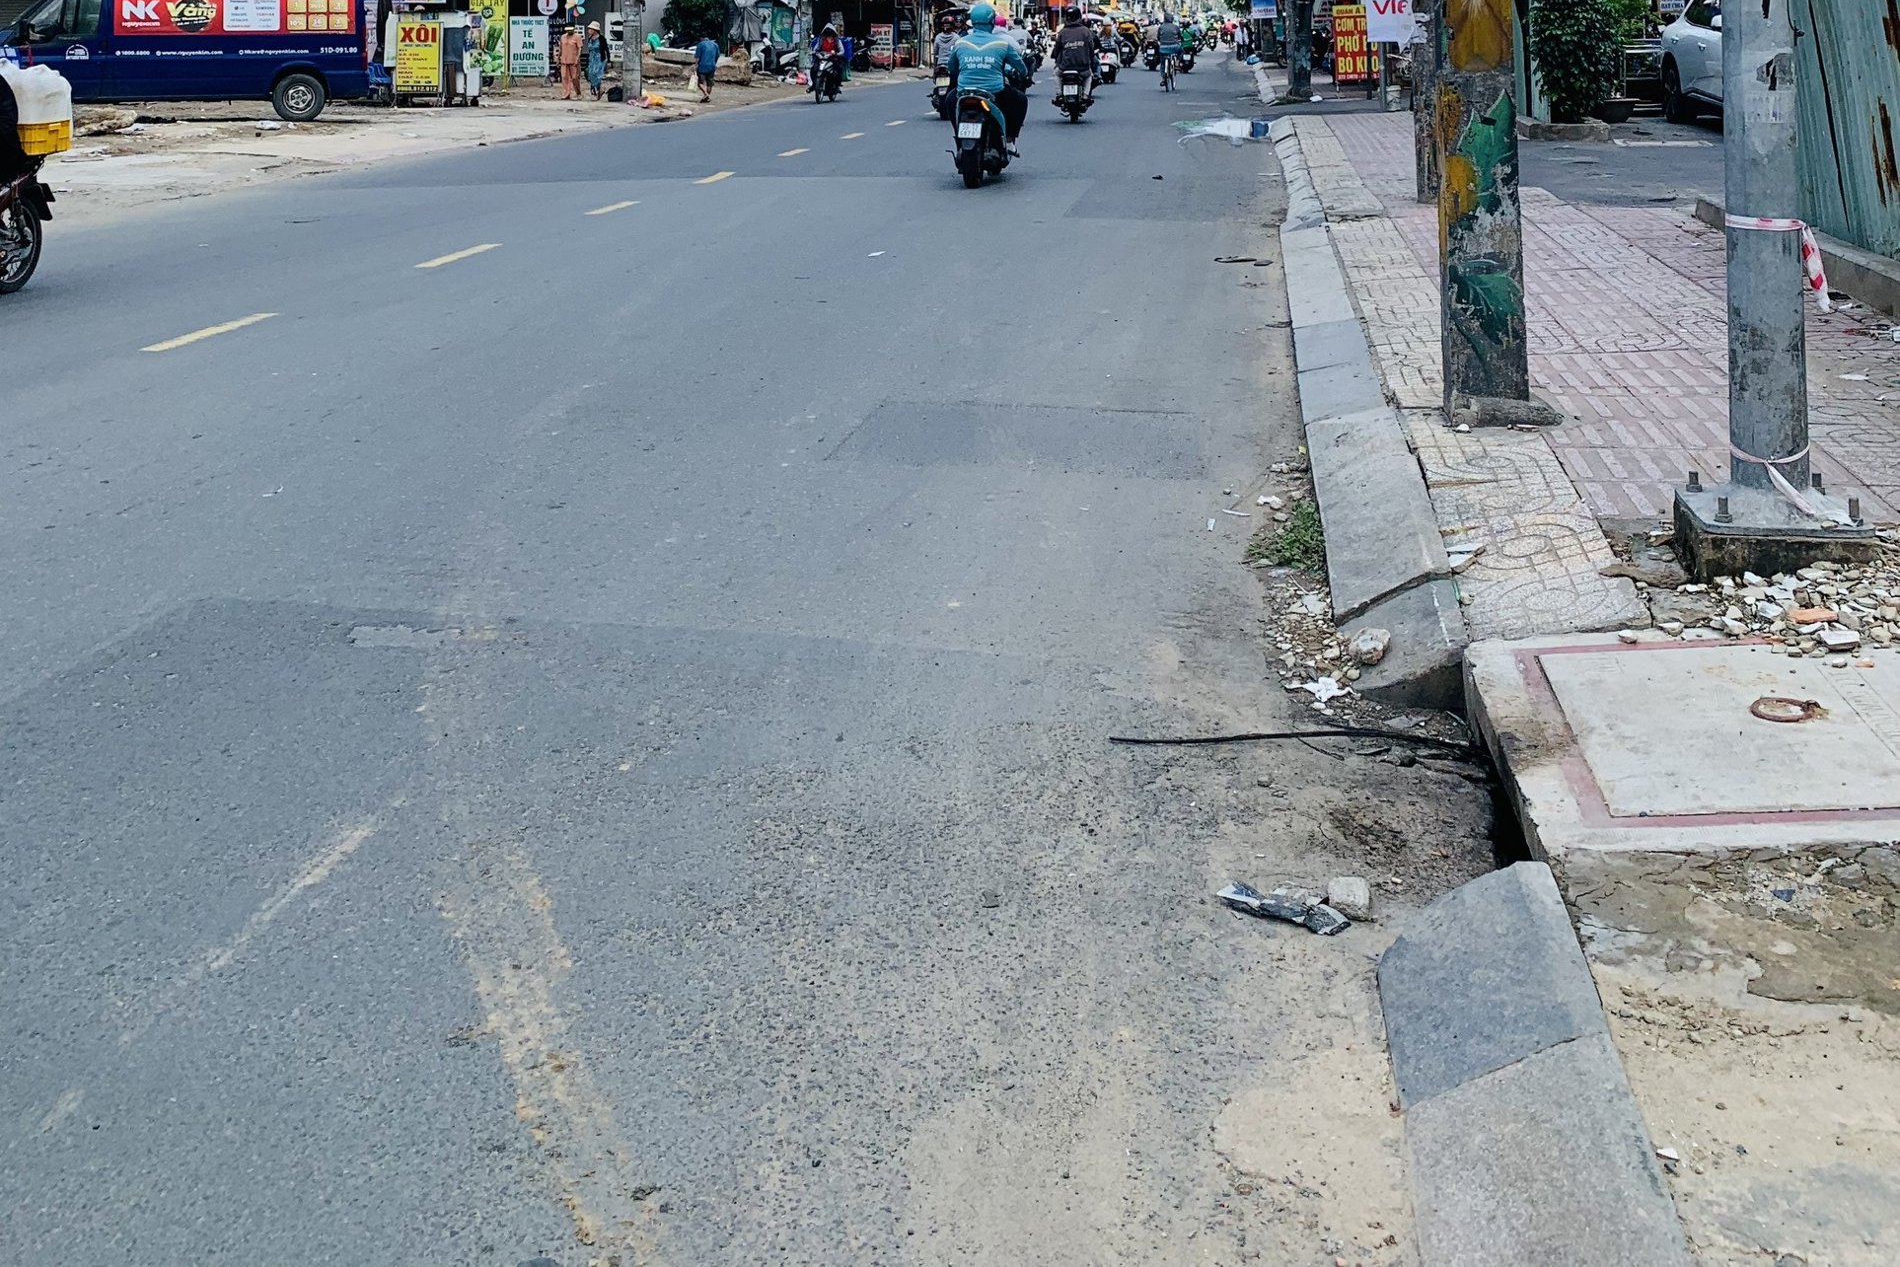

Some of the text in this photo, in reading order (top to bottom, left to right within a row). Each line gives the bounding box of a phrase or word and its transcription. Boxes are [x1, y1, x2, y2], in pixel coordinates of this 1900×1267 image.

[122, 0, 160, 20] NK
[1335, 17, 1354, 32] CƠM
[400, 24, 437, 47] XÔI
[522, 41, 535, 50] AN
[1337, 31, 1360, 53] PHỞ
[1338, 53, 1353, 74] BÒ
